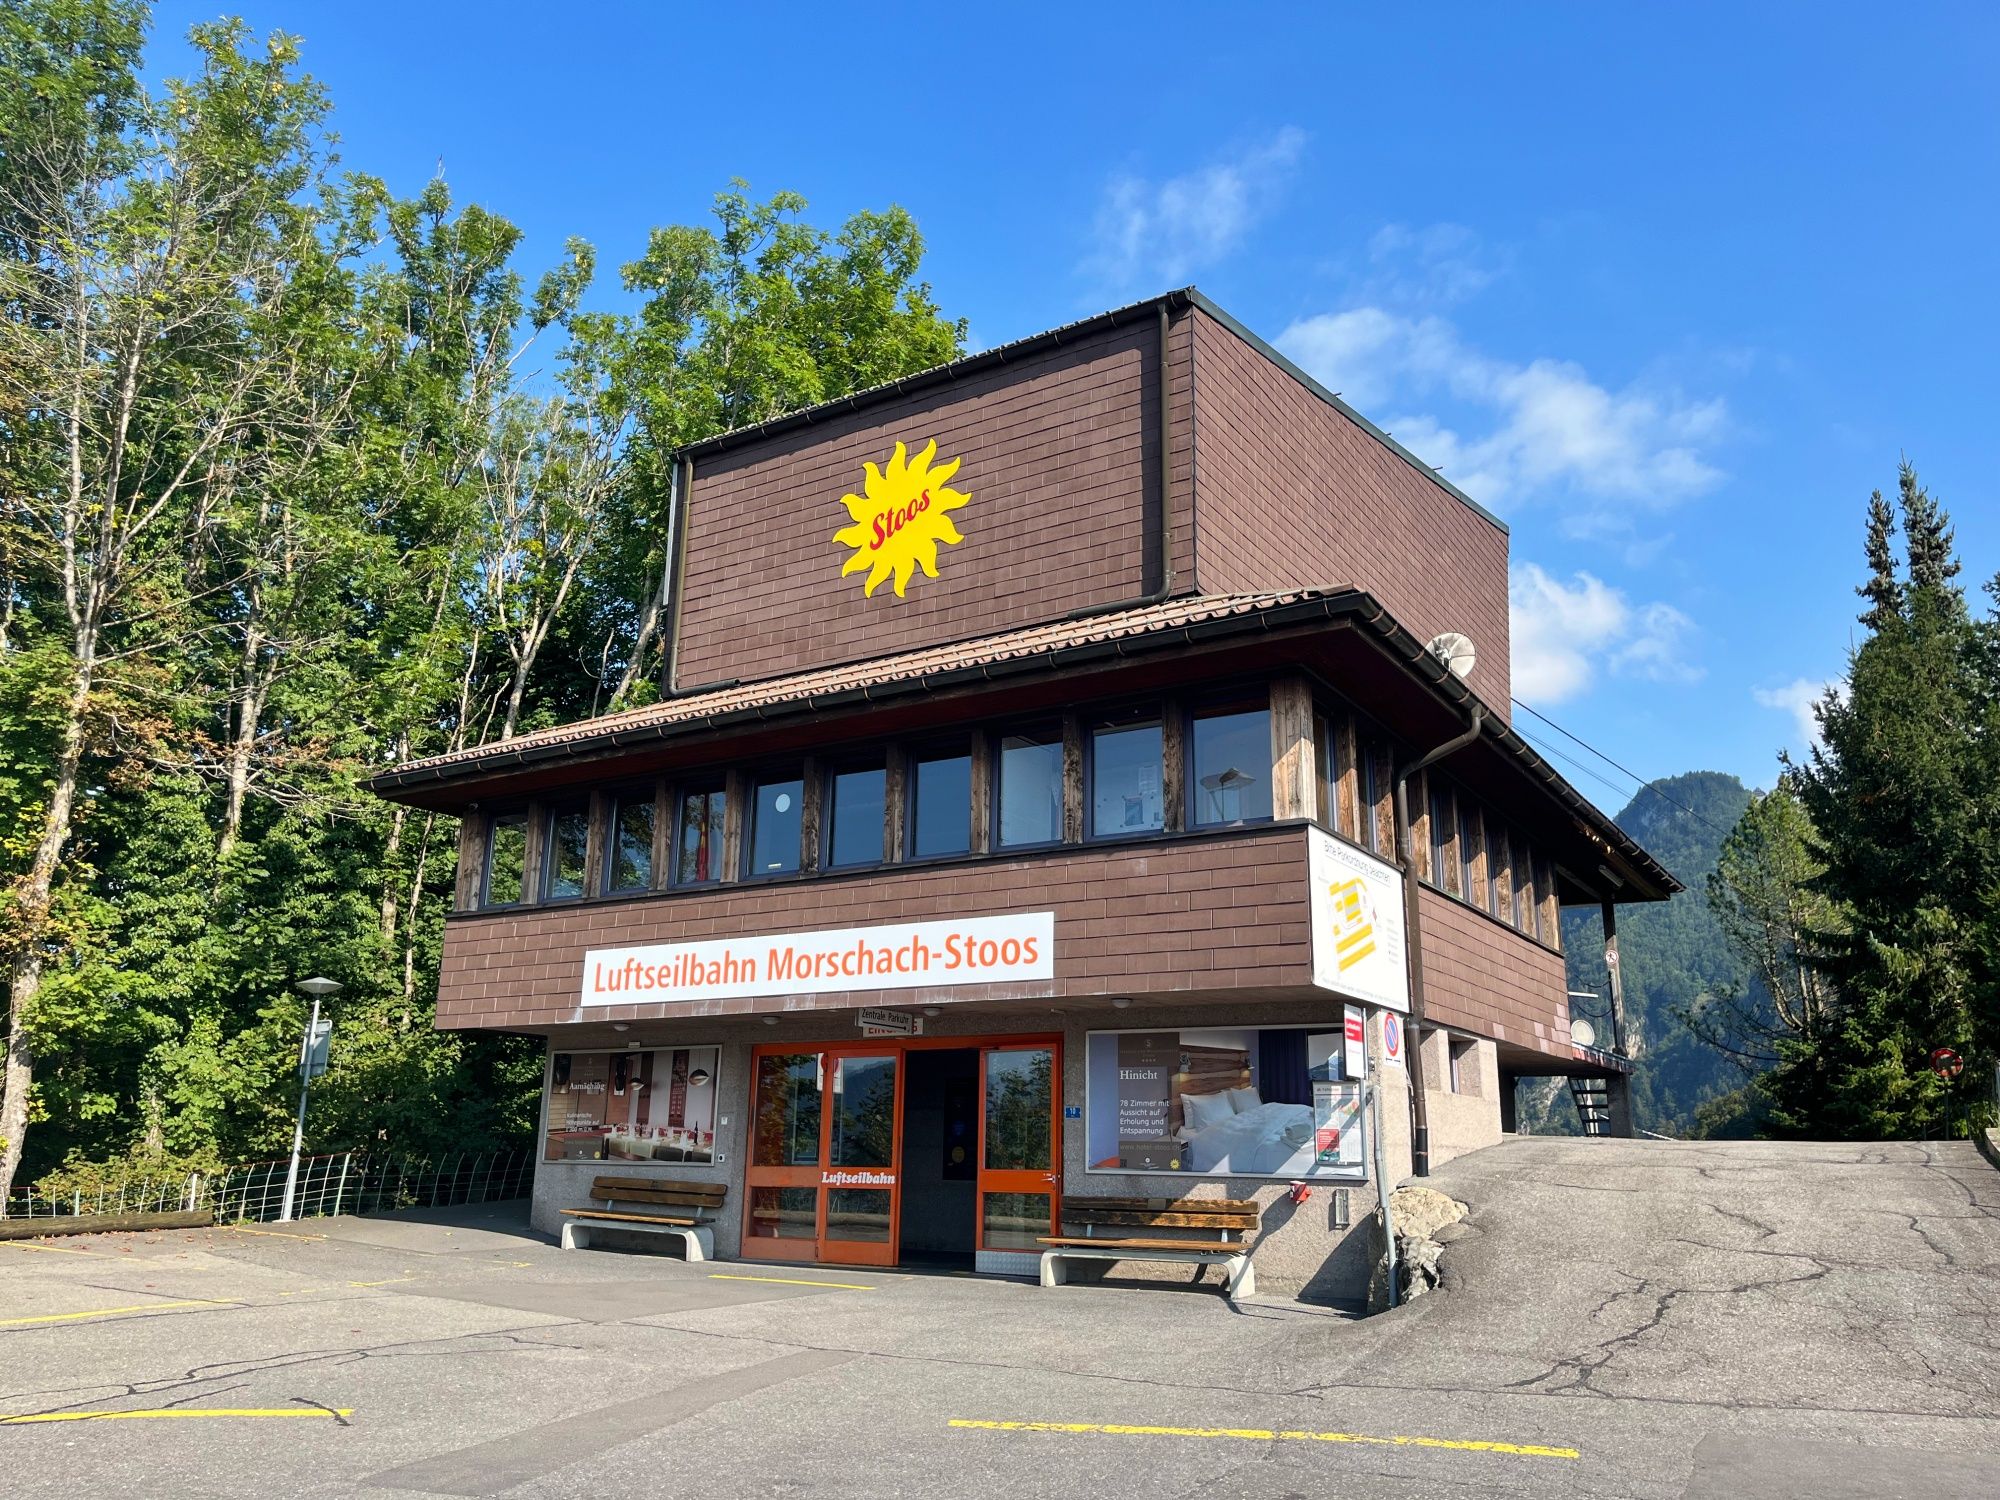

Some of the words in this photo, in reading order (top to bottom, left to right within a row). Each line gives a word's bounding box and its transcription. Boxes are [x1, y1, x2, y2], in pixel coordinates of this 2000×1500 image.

[870, 488, 931, 551] Stoos
[594, 949, 757, 992] Luftseilbahn
[766, 932, 1039, 981] Morschach-Stoos
[862, 1008, 886, 1021] Zentrale
[888, 1012, 910, 1024] Parkuhr
[1119, 1069, 1158, 1080] Hinicht
[1120, 1099, 1129, 1107] 78
[1130, 1099, 1157, 1107] Zimmer
[1158, 1098, 1170, 1107] mit
[1119, 1108, 1148, 1116] Aussicht
[1149, 1108, 1160, 1116] auf
[1119, 1117, 1149, 1126] Erholung
[1151, 1117, 1164, 1125] und
[1119, 1127, 1164, 1136] Entspannung
[821, 1170, 896, 1186] Luftseilbahn
